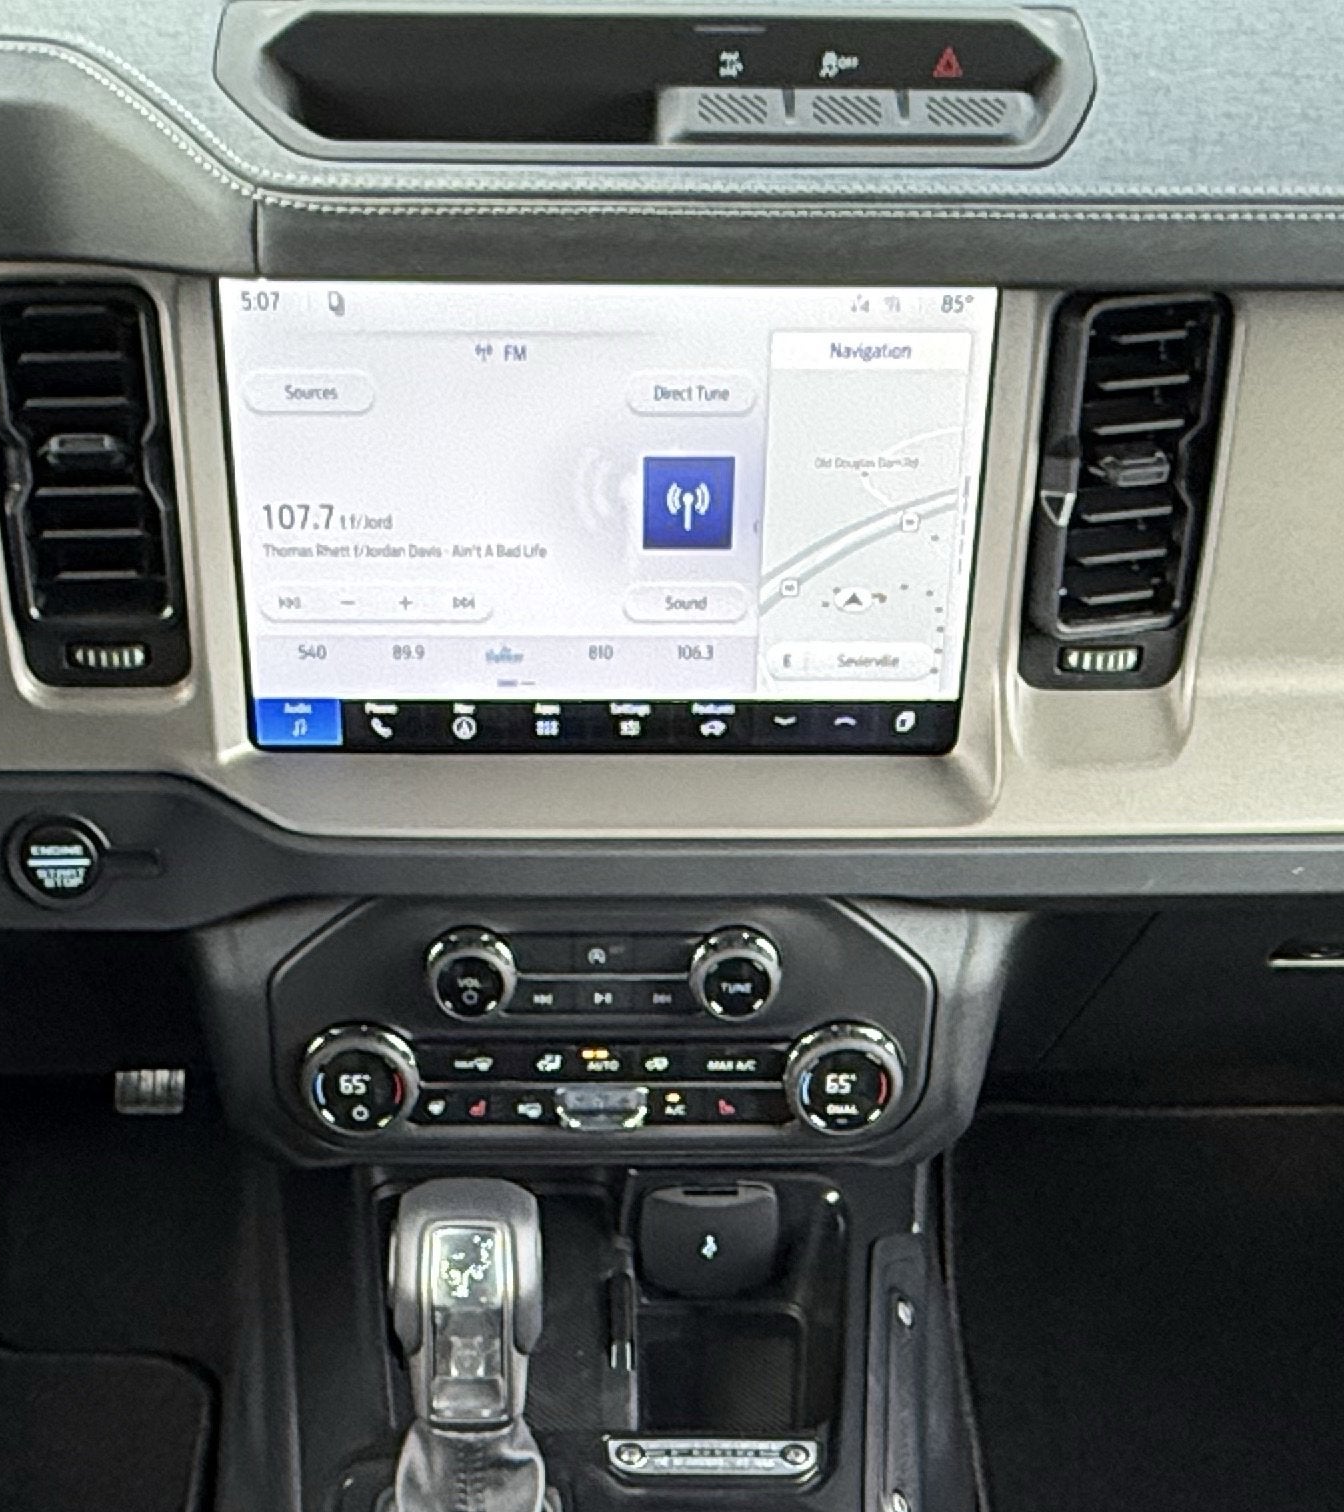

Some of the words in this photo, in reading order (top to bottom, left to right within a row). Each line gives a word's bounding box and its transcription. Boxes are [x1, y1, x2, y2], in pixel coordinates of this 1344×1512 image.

[241, 290, 280, 312] 5:07
[940, 294, 975, 314] 85°
[503, 344, 527, 361] FM
[829, 342, 912, 361] Navigation
[284, 384, 338, 400] Sources
[653, 384, 693, 401] Direct
[696, 384, 730, 401] Tune
[262, 503, 334, 530] 107.7
[263, 543, 313, 558] Thomas
[316, 543, 351, 558] Rhett
[408, 544, 442, 558] Davis
[484, 544, 494, 559] A
[496, 544, 522, 559] Bad
[665, 595, 708, 611] Sound
[298, 644, 327, 660] 540
[392, 644, 425, 660] 89.9
[588, 644, 614, 660] 810
[678, 644, 714, 660] 106.3
[586, 1059, 620, 1072] AUTO
[339, 1073, 372, 1096] 65°
[824, 1073, 858, 1096] 65°
